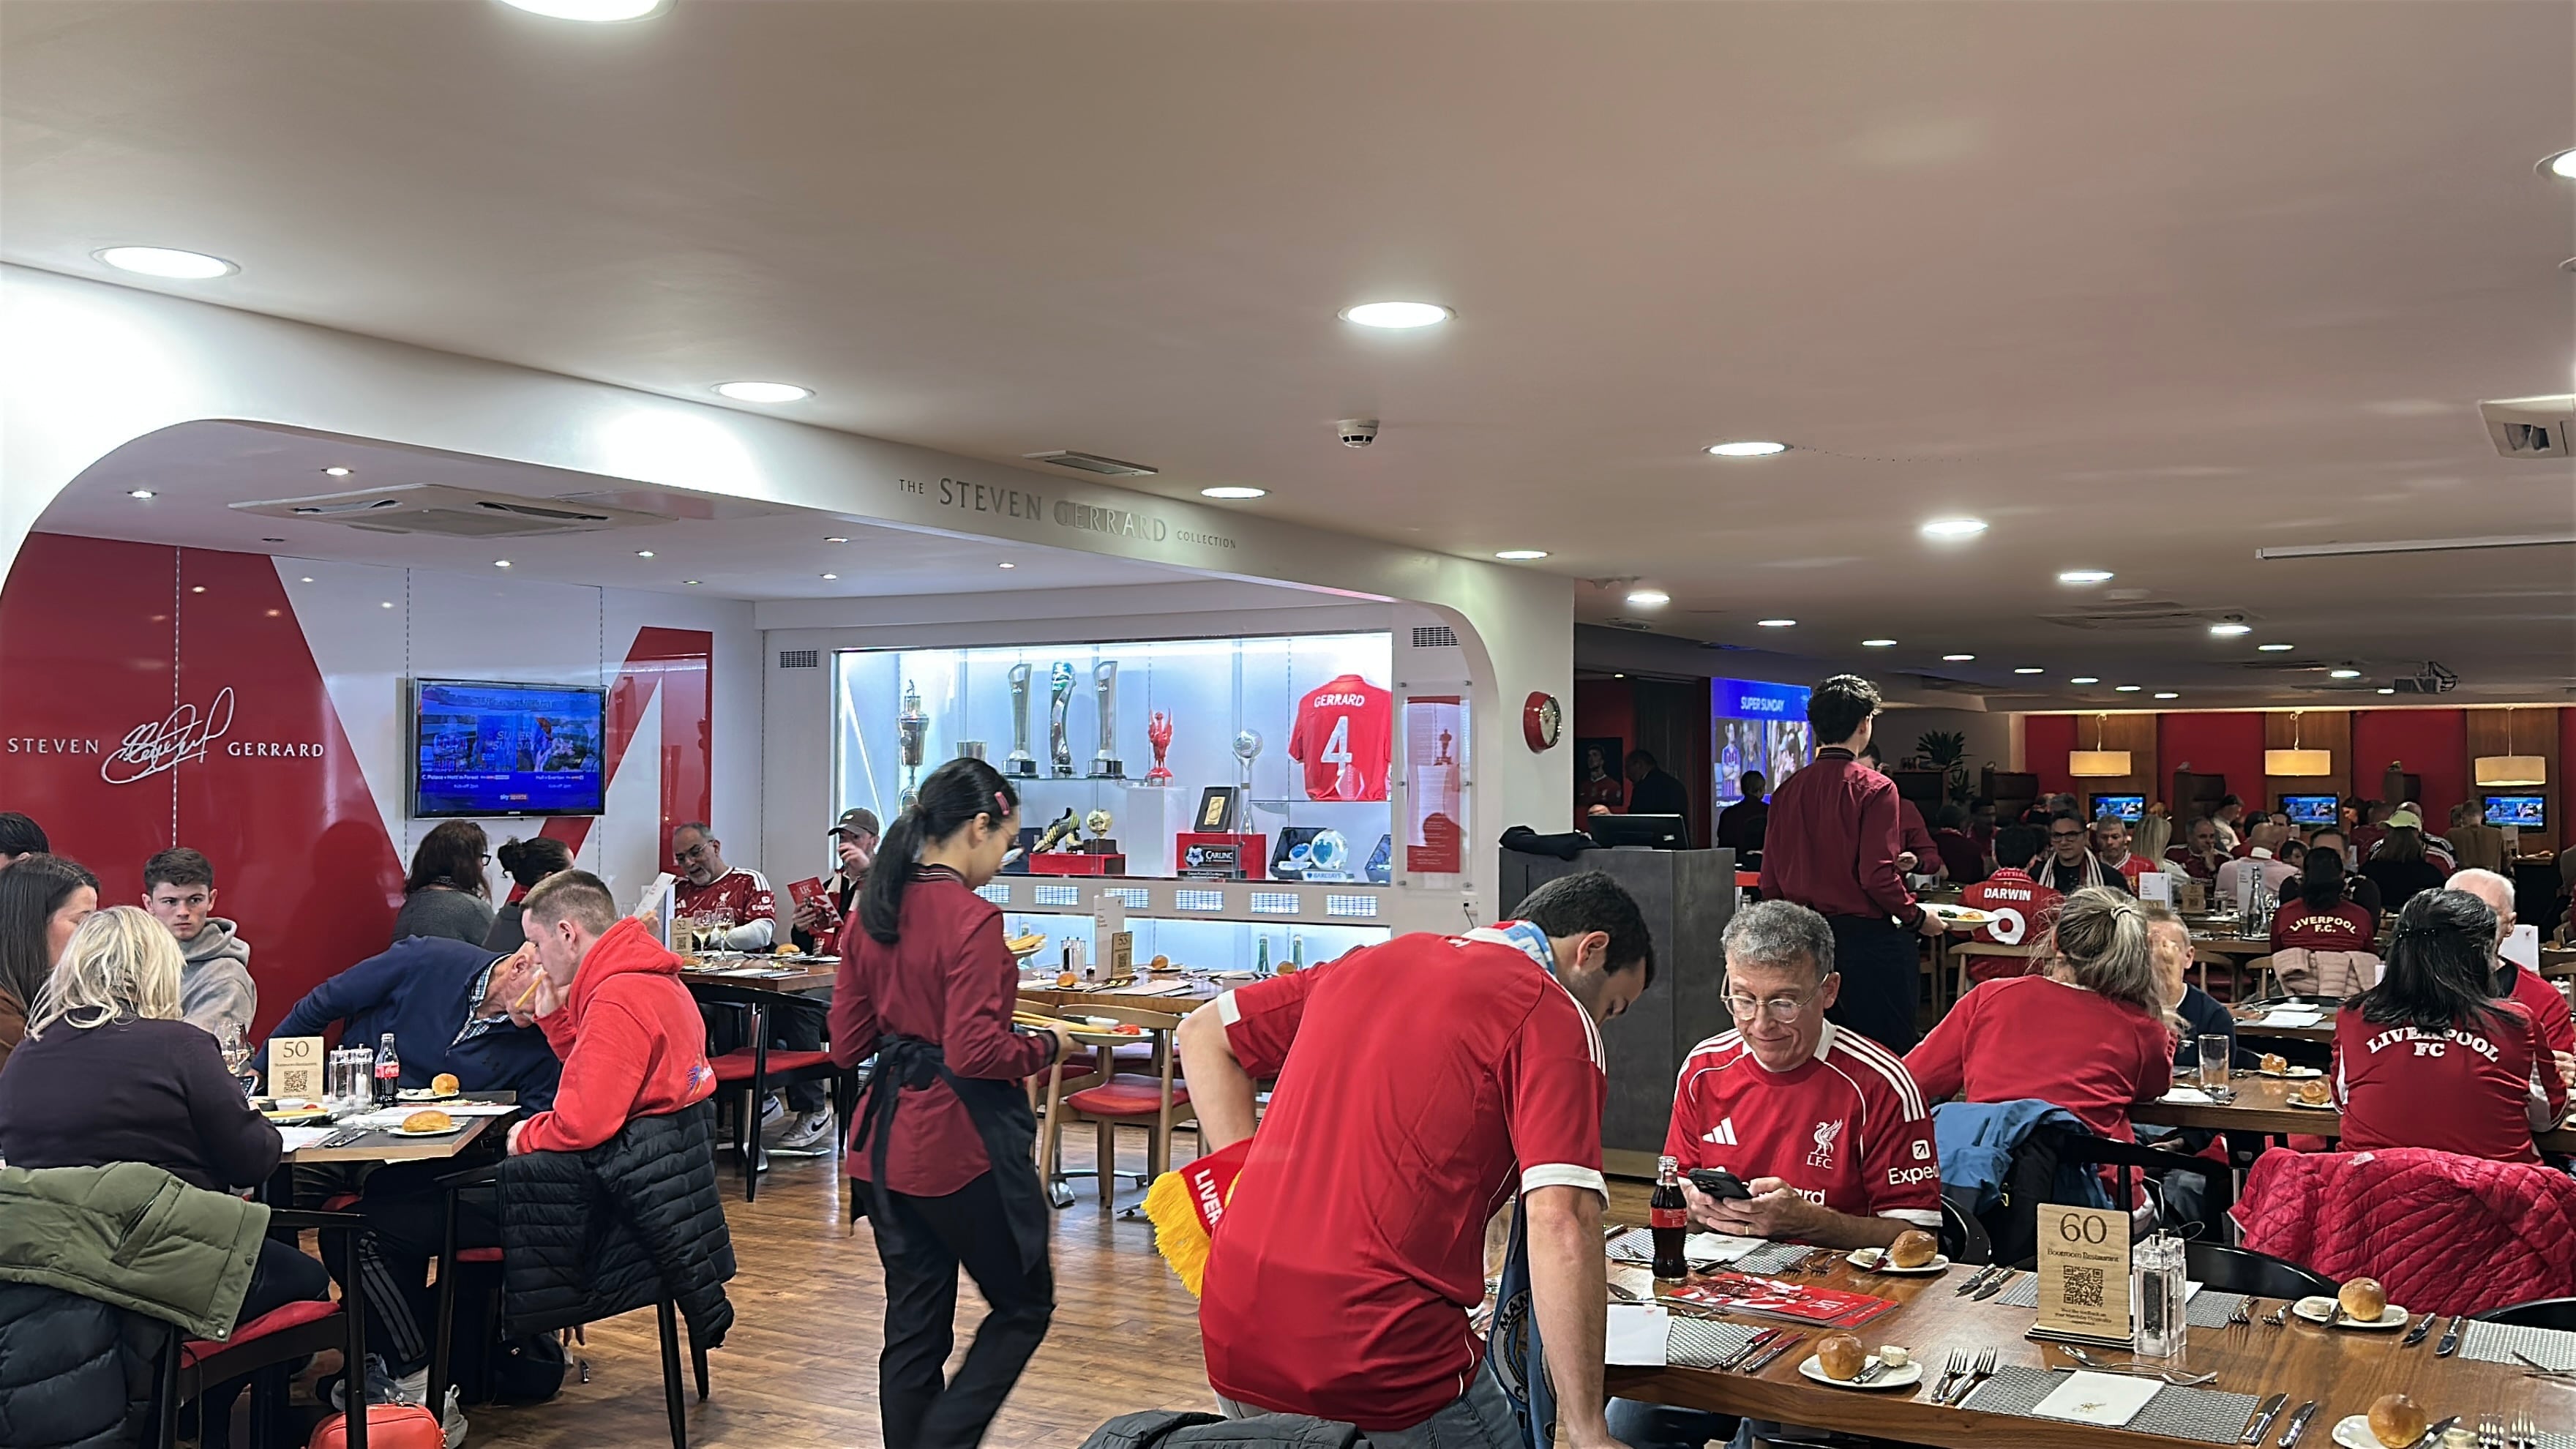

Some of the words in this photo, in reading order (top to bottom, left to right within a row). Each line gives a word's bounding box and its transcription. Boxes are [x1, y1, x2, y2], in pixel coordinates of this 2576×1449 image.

[899, 479, 924, 495] THE
[940, 477, 1041, 521] STEVEN
[1053, 500, 1167, 542] GERRARD
[1177, 530, 1237, 550] COLLECTION
[1314, 694, 1365, 708] GERRARD
[1740, 696, 1761, 711] SUPER
[1761, 699, 1785, 713] SUNDAY
[7, 738, 100, 755] STEVEN
[228, 741, 324, 758] GERRARD
[1320, 715, 1353, 776] 4
[1984, 888, 2032, 901] DARWIN
[2290, 916, 2356, 935] LIVERPOOL
[2315, 924, 2336, 933] F.C.
[283, 1041, 310, 1058] 50
[2414, 1042, 2446, 1057] FC
[2060, 1213, 2108, 1244] 60
